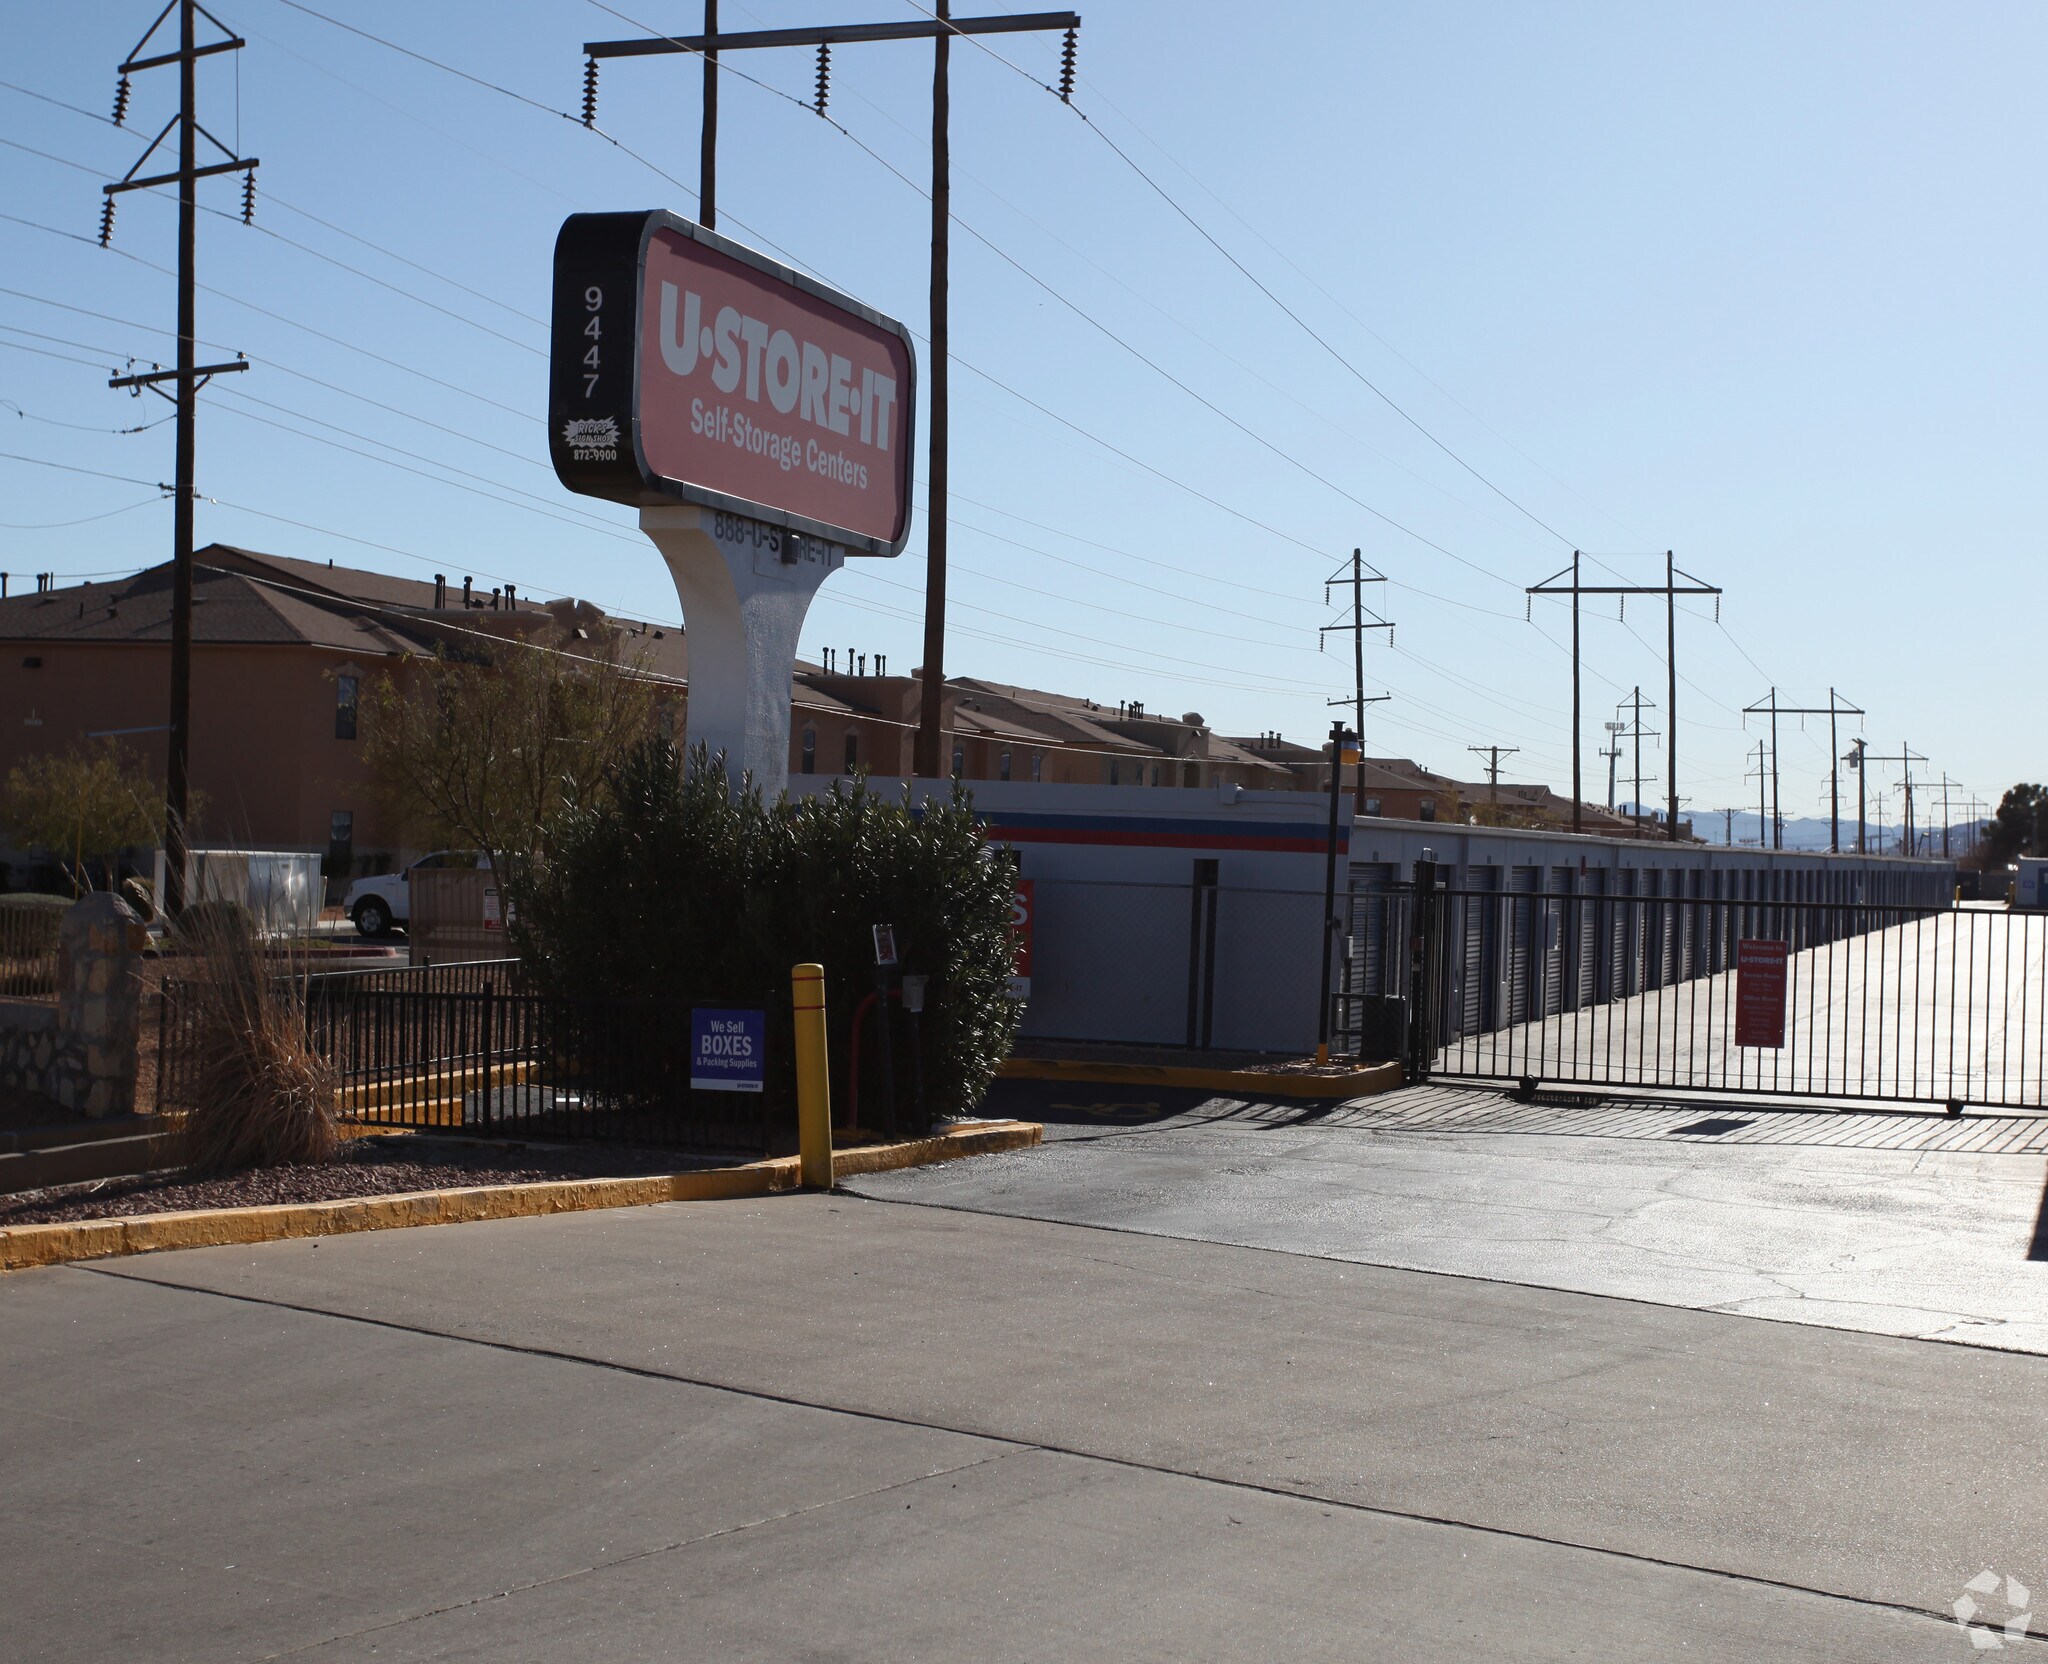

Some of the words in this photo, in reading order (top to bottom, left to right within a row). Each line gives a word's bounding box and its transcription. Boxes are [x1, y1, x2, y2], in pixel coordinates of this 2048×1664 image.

[583, 286, 603, 398] 9447
[574, 434, 592, 443] SIGN
[592, 434, 612, 443] SHOP
[690, 398, 801, 471] Self-Storage
[806, 438, 868, 489] Centers
[573, 449, 617, 461] 872-9900
[714, 511, 834, 567] 888-U-SRE-IT
[1742, 943, 1774, 951] Welcome
[711, 1020, 725, 1032] We
[726, 1020, 744, 1033] Sell
[701, 1034, 752, 1056] BOXES
[696, 1057, 702, 1066] &
[703, 1057, 729, 1068] Packing
[729, 1058, 757, 1069] Supplies
